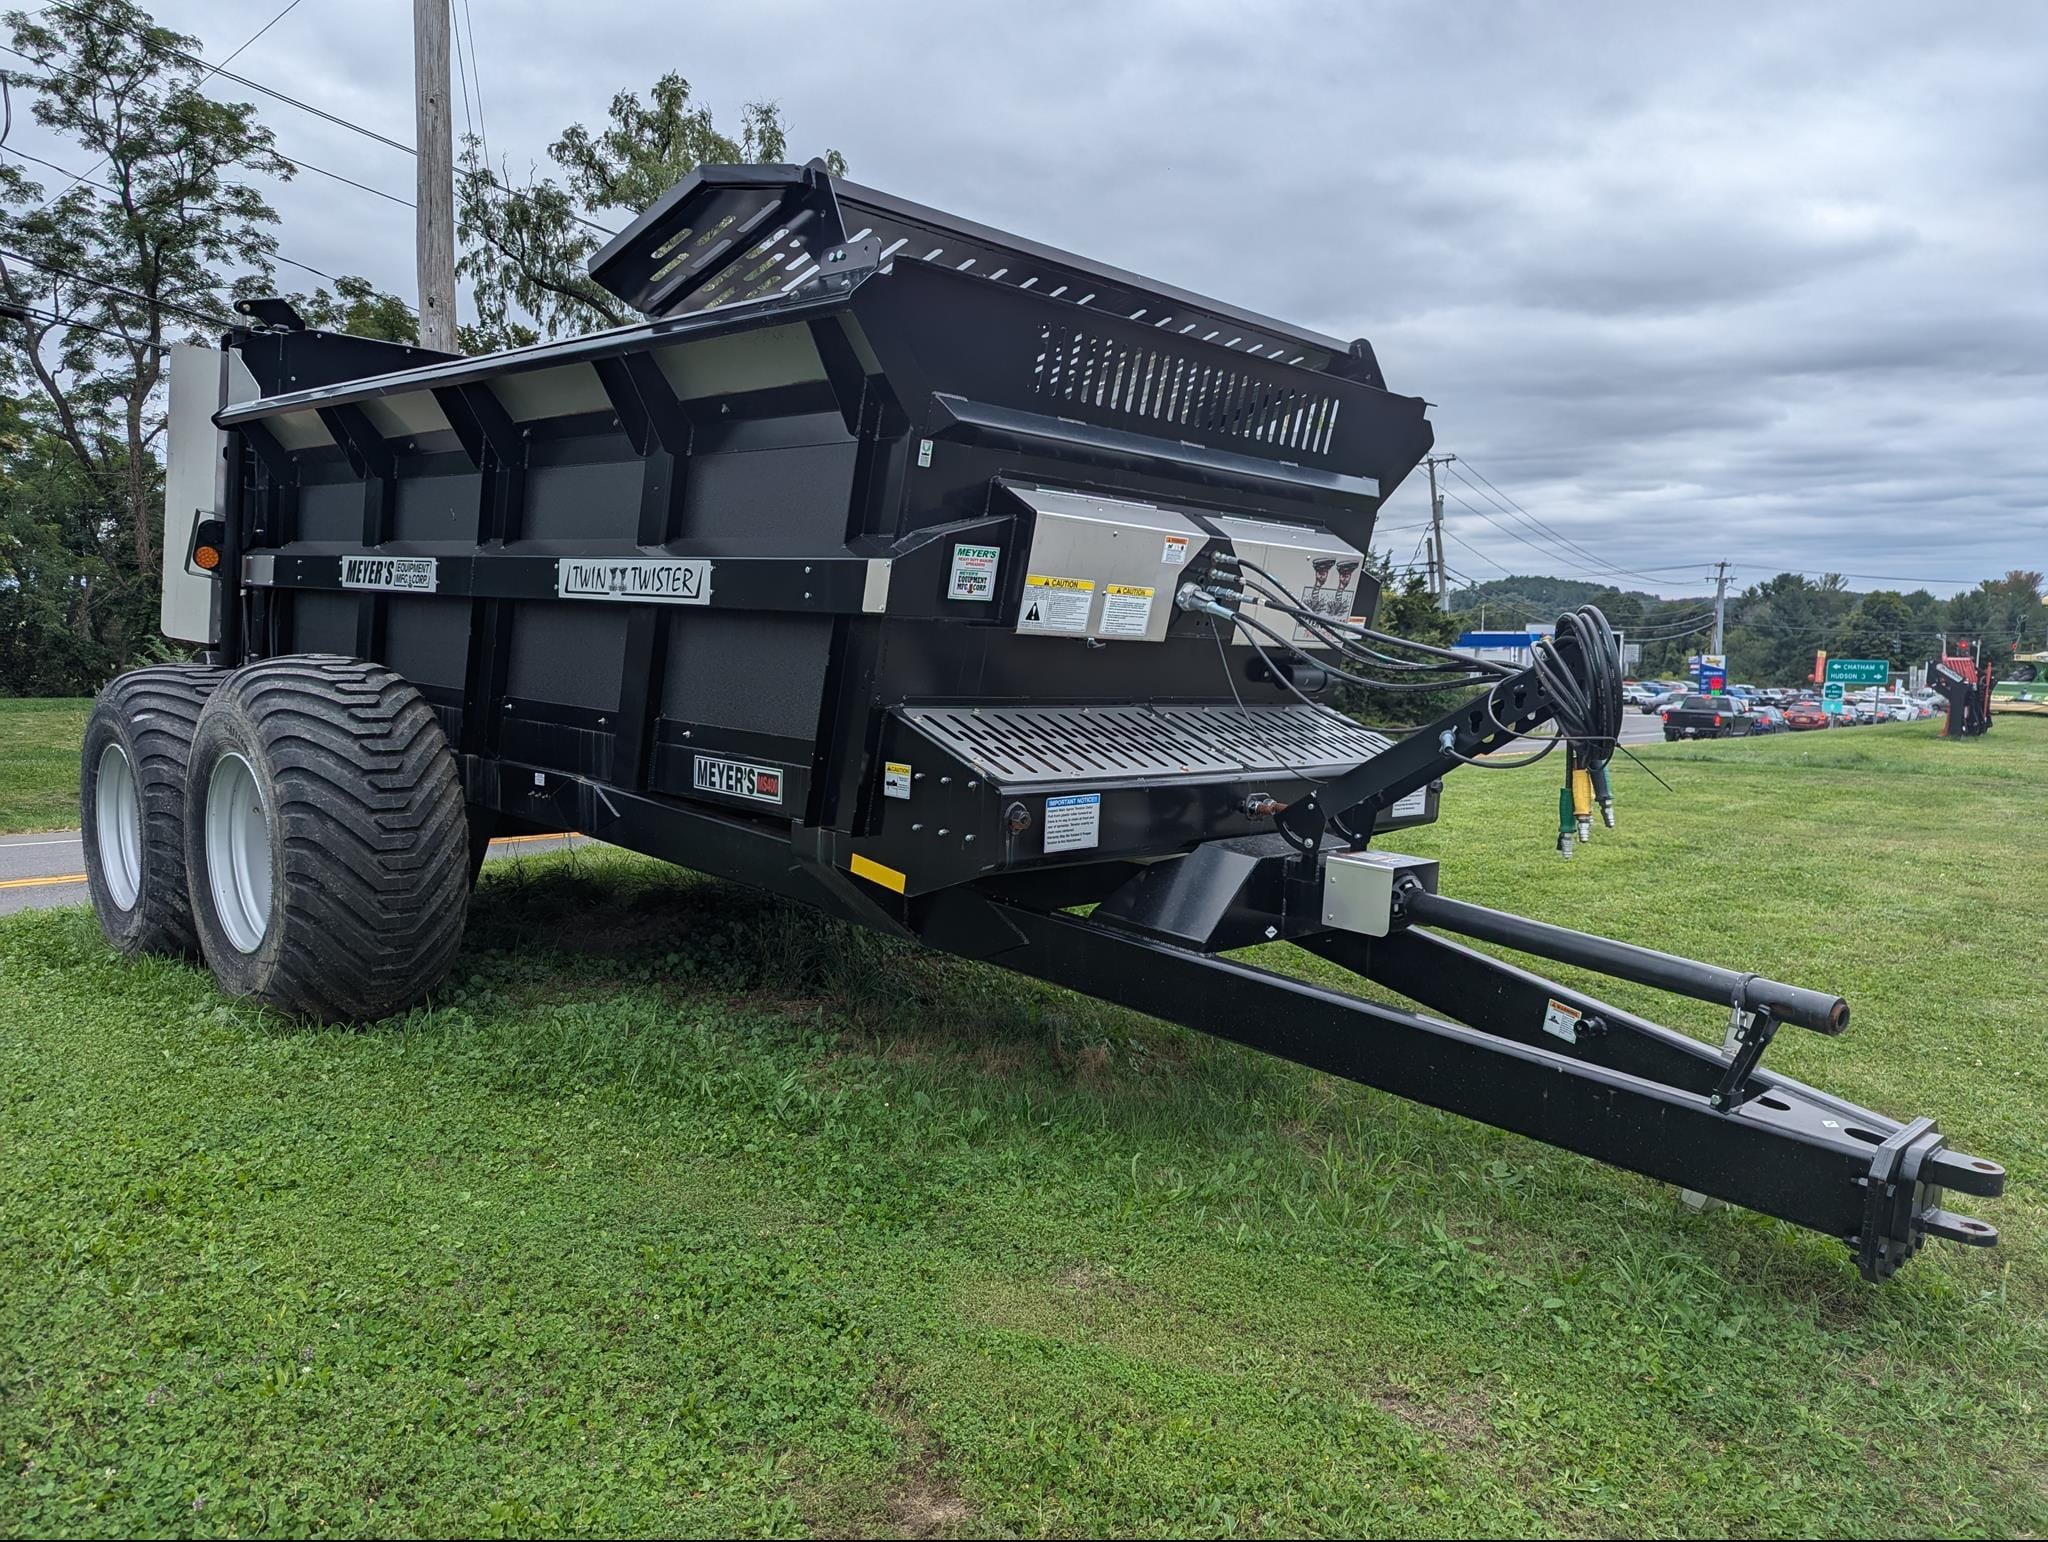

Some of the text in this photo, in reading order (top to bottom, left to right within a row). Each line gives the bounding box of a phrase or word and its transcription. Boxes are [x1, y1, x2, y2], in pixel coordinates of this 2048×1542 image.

[957, 548, 997, 558] MEYER'S
[346, 560, 395, 585] MEYER'S
[396, 563, 430, 573] EQUIPMENT
[573, 565, 694, 594] TWIN TWISTER
[958, 575, 987, 584] EQUIPMENT
[1051, 579, 1079, 588] CAUTION
[1123, 587, 1146, 596] CAUTION
[1830, 672, 1858, 680] HUDSON
[697, 760, 756, 795] MEYER'S
[1048, 798, 1076, 806] IMPORTANT
